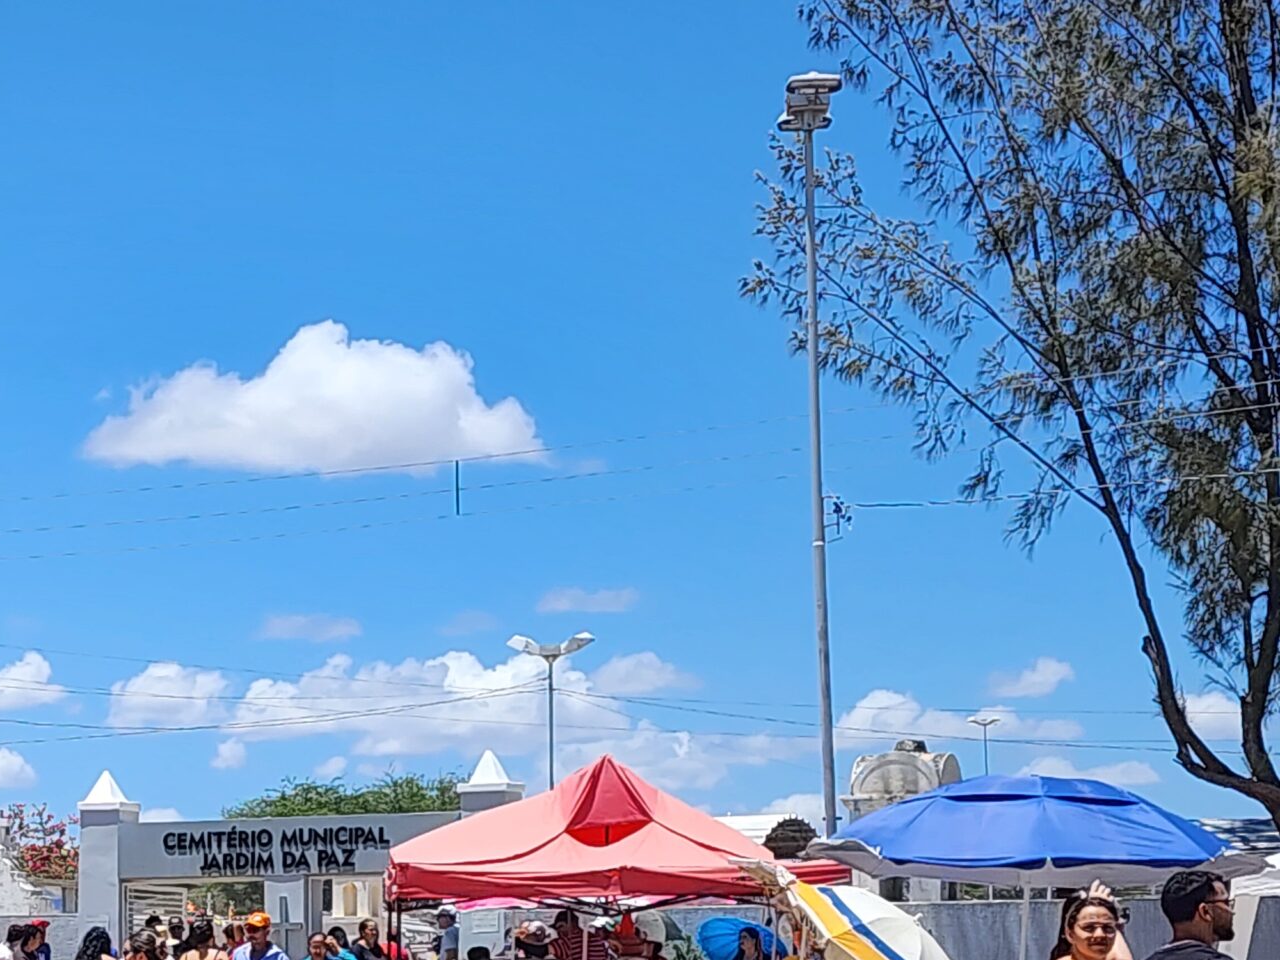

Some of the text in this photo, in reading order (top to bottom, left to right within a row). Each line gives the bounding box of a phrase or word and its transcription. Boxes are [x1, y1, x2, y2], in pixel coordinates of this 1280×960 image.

[163, 826, 390, 852] CEMITÉRIO MUNICIPAL
[200, 849, 356, 872] JARDIM DA PAZ
